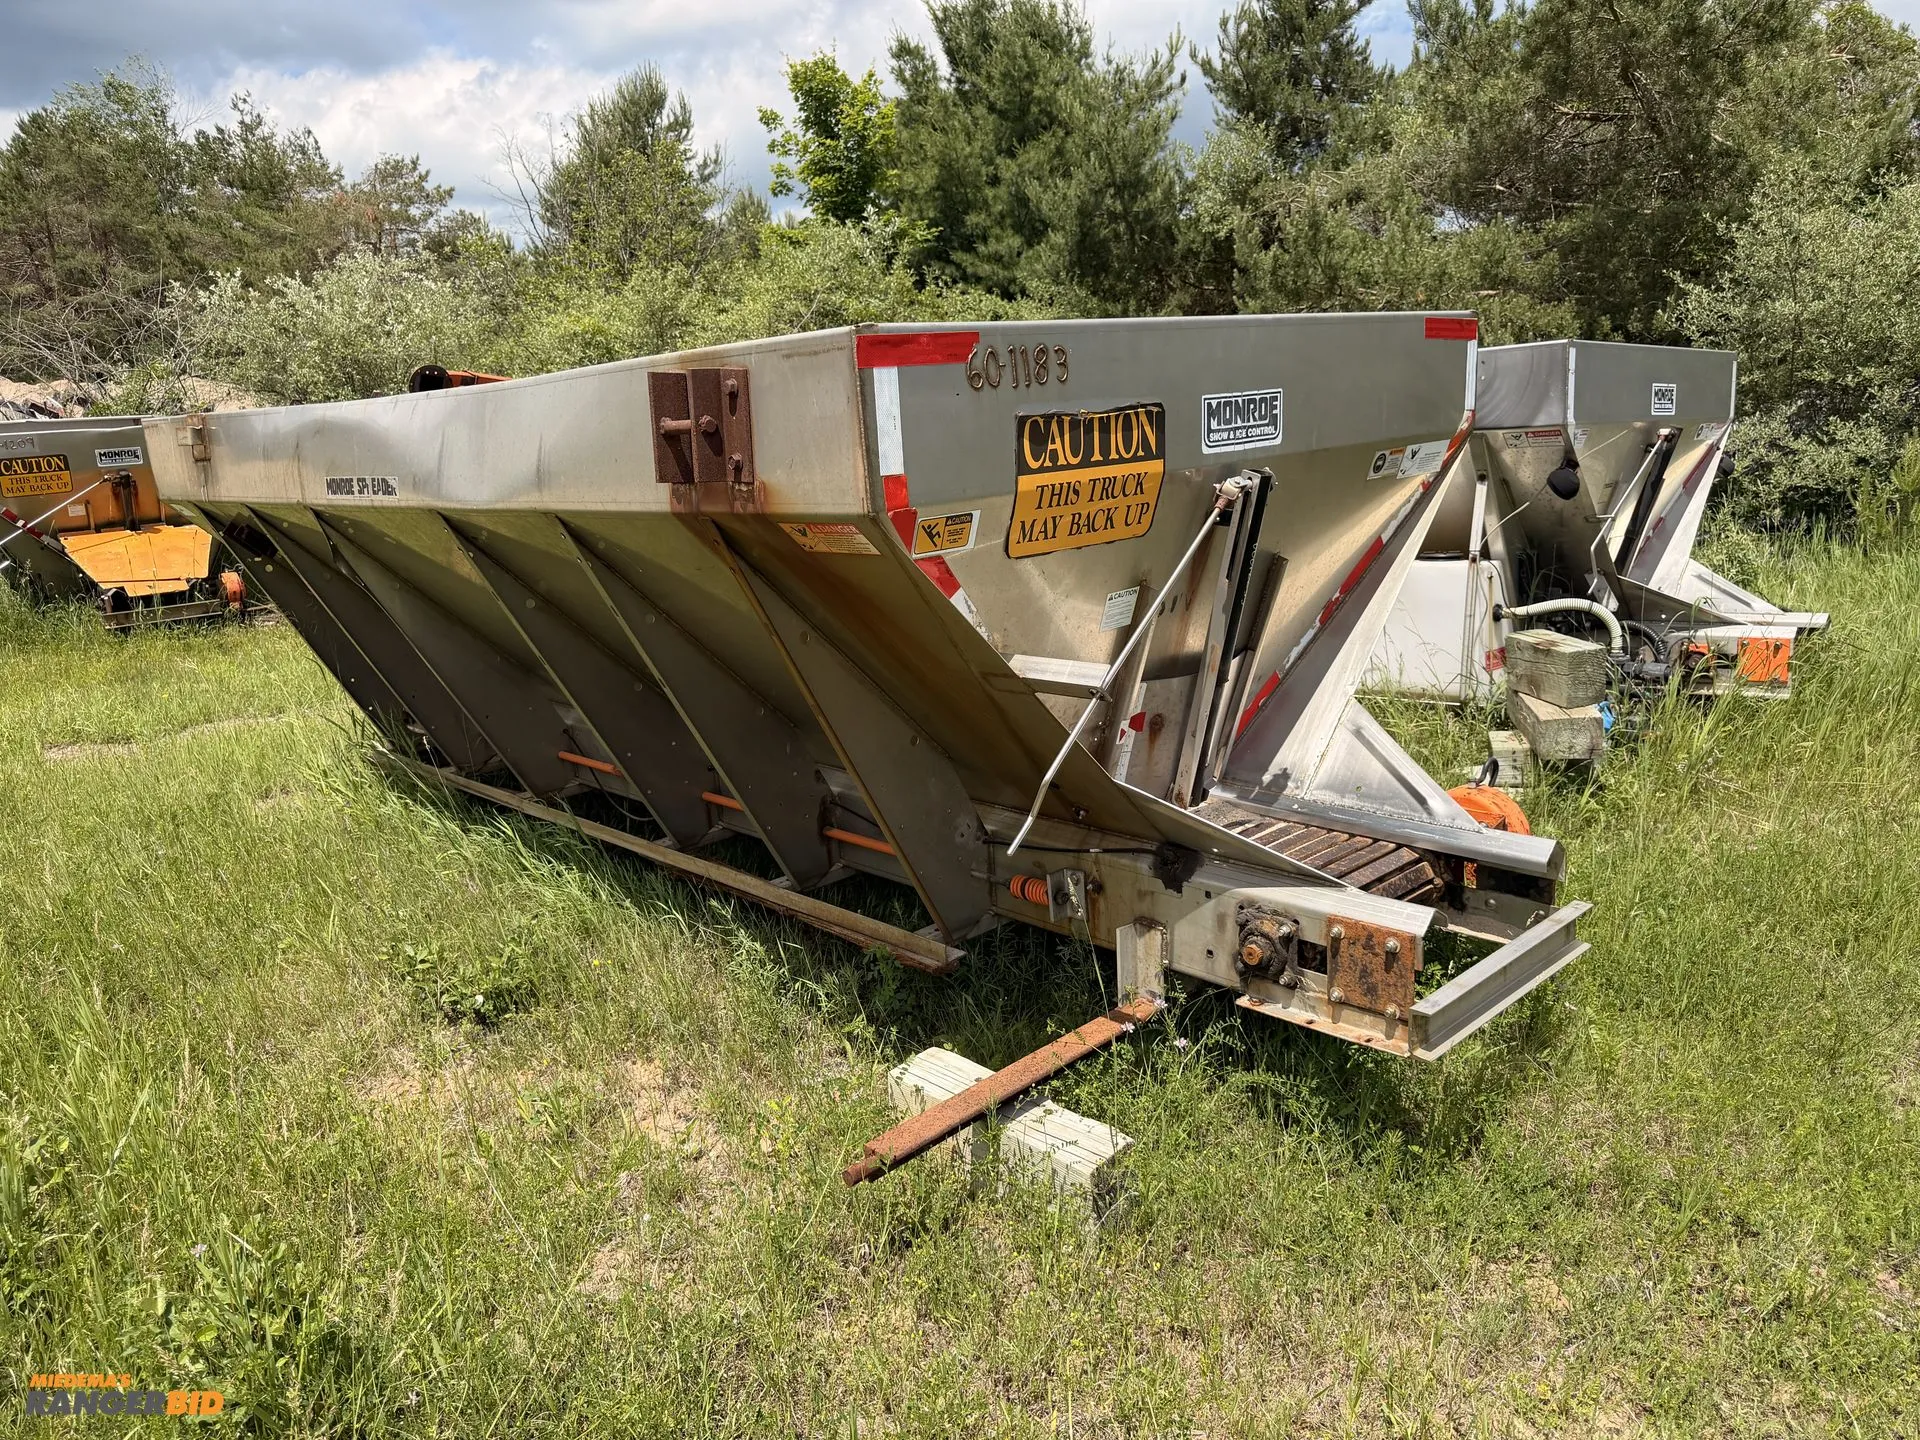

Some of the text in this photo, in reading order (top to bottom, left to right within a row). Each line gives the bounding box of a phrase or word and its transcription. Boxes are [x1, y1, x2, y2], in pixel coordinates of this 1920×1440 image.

[965, 344, 1069, 389] 60-1183
[1206, 395, 1279, 428] MONROE
[1023, 408, 1160, 469] CAUTION
[1209, 426, 1276, 442] SNOW & ICE CONTROL
[98, 449, 140, 463] MONROE
[0, 456, 66, 475] CAUTION
[5, 481, 69, 494] MAY BACK UP
[8, 473, 63, 485] THIS TRUCK
[325, 477, 355, 496] MONROE
[1035, 472, 1149, 510] THIS TRUCK
[951, 515, 971, 524] CAUTION
[1016, 501, 1150, 544] MAY BACK UP
[821, 523, 860, 534] DANGER
[1113, 589, 1138, 600] CAUTION
